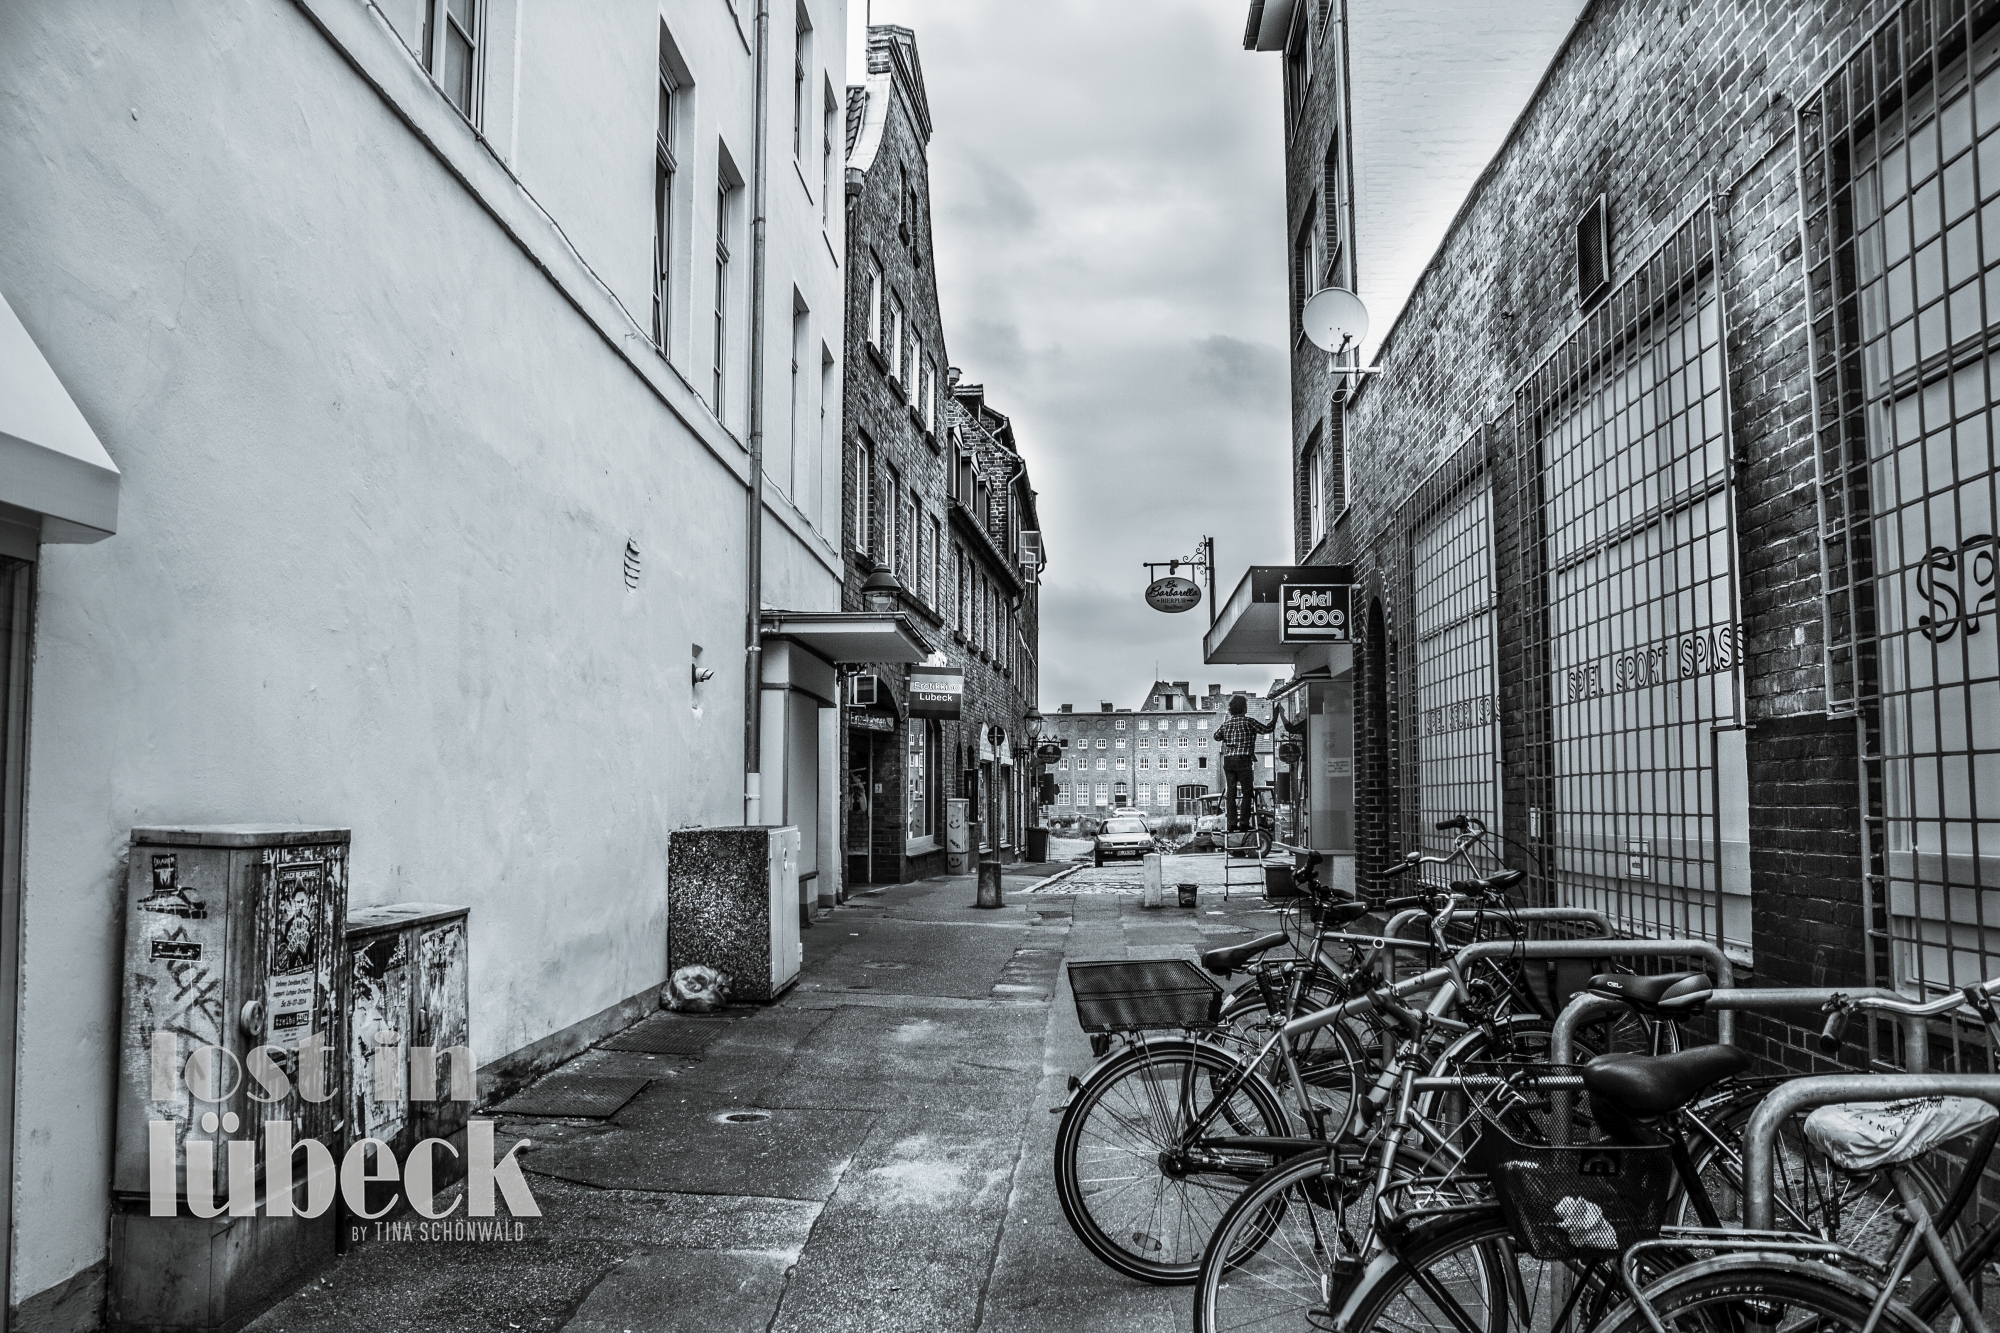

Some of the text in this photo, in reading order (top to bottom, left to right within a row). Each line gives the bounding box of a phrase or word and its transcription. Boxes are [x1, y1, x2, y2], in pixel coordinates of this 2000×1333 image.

[1916, 533, 2000, 644] SP
[1287, 589, 1332, 610] Spiel
[1286, 609, 1345, 626] 2000
[914, 681, 961, 691] Erotikkino
[919, 692, 953, 702] Lübeck
